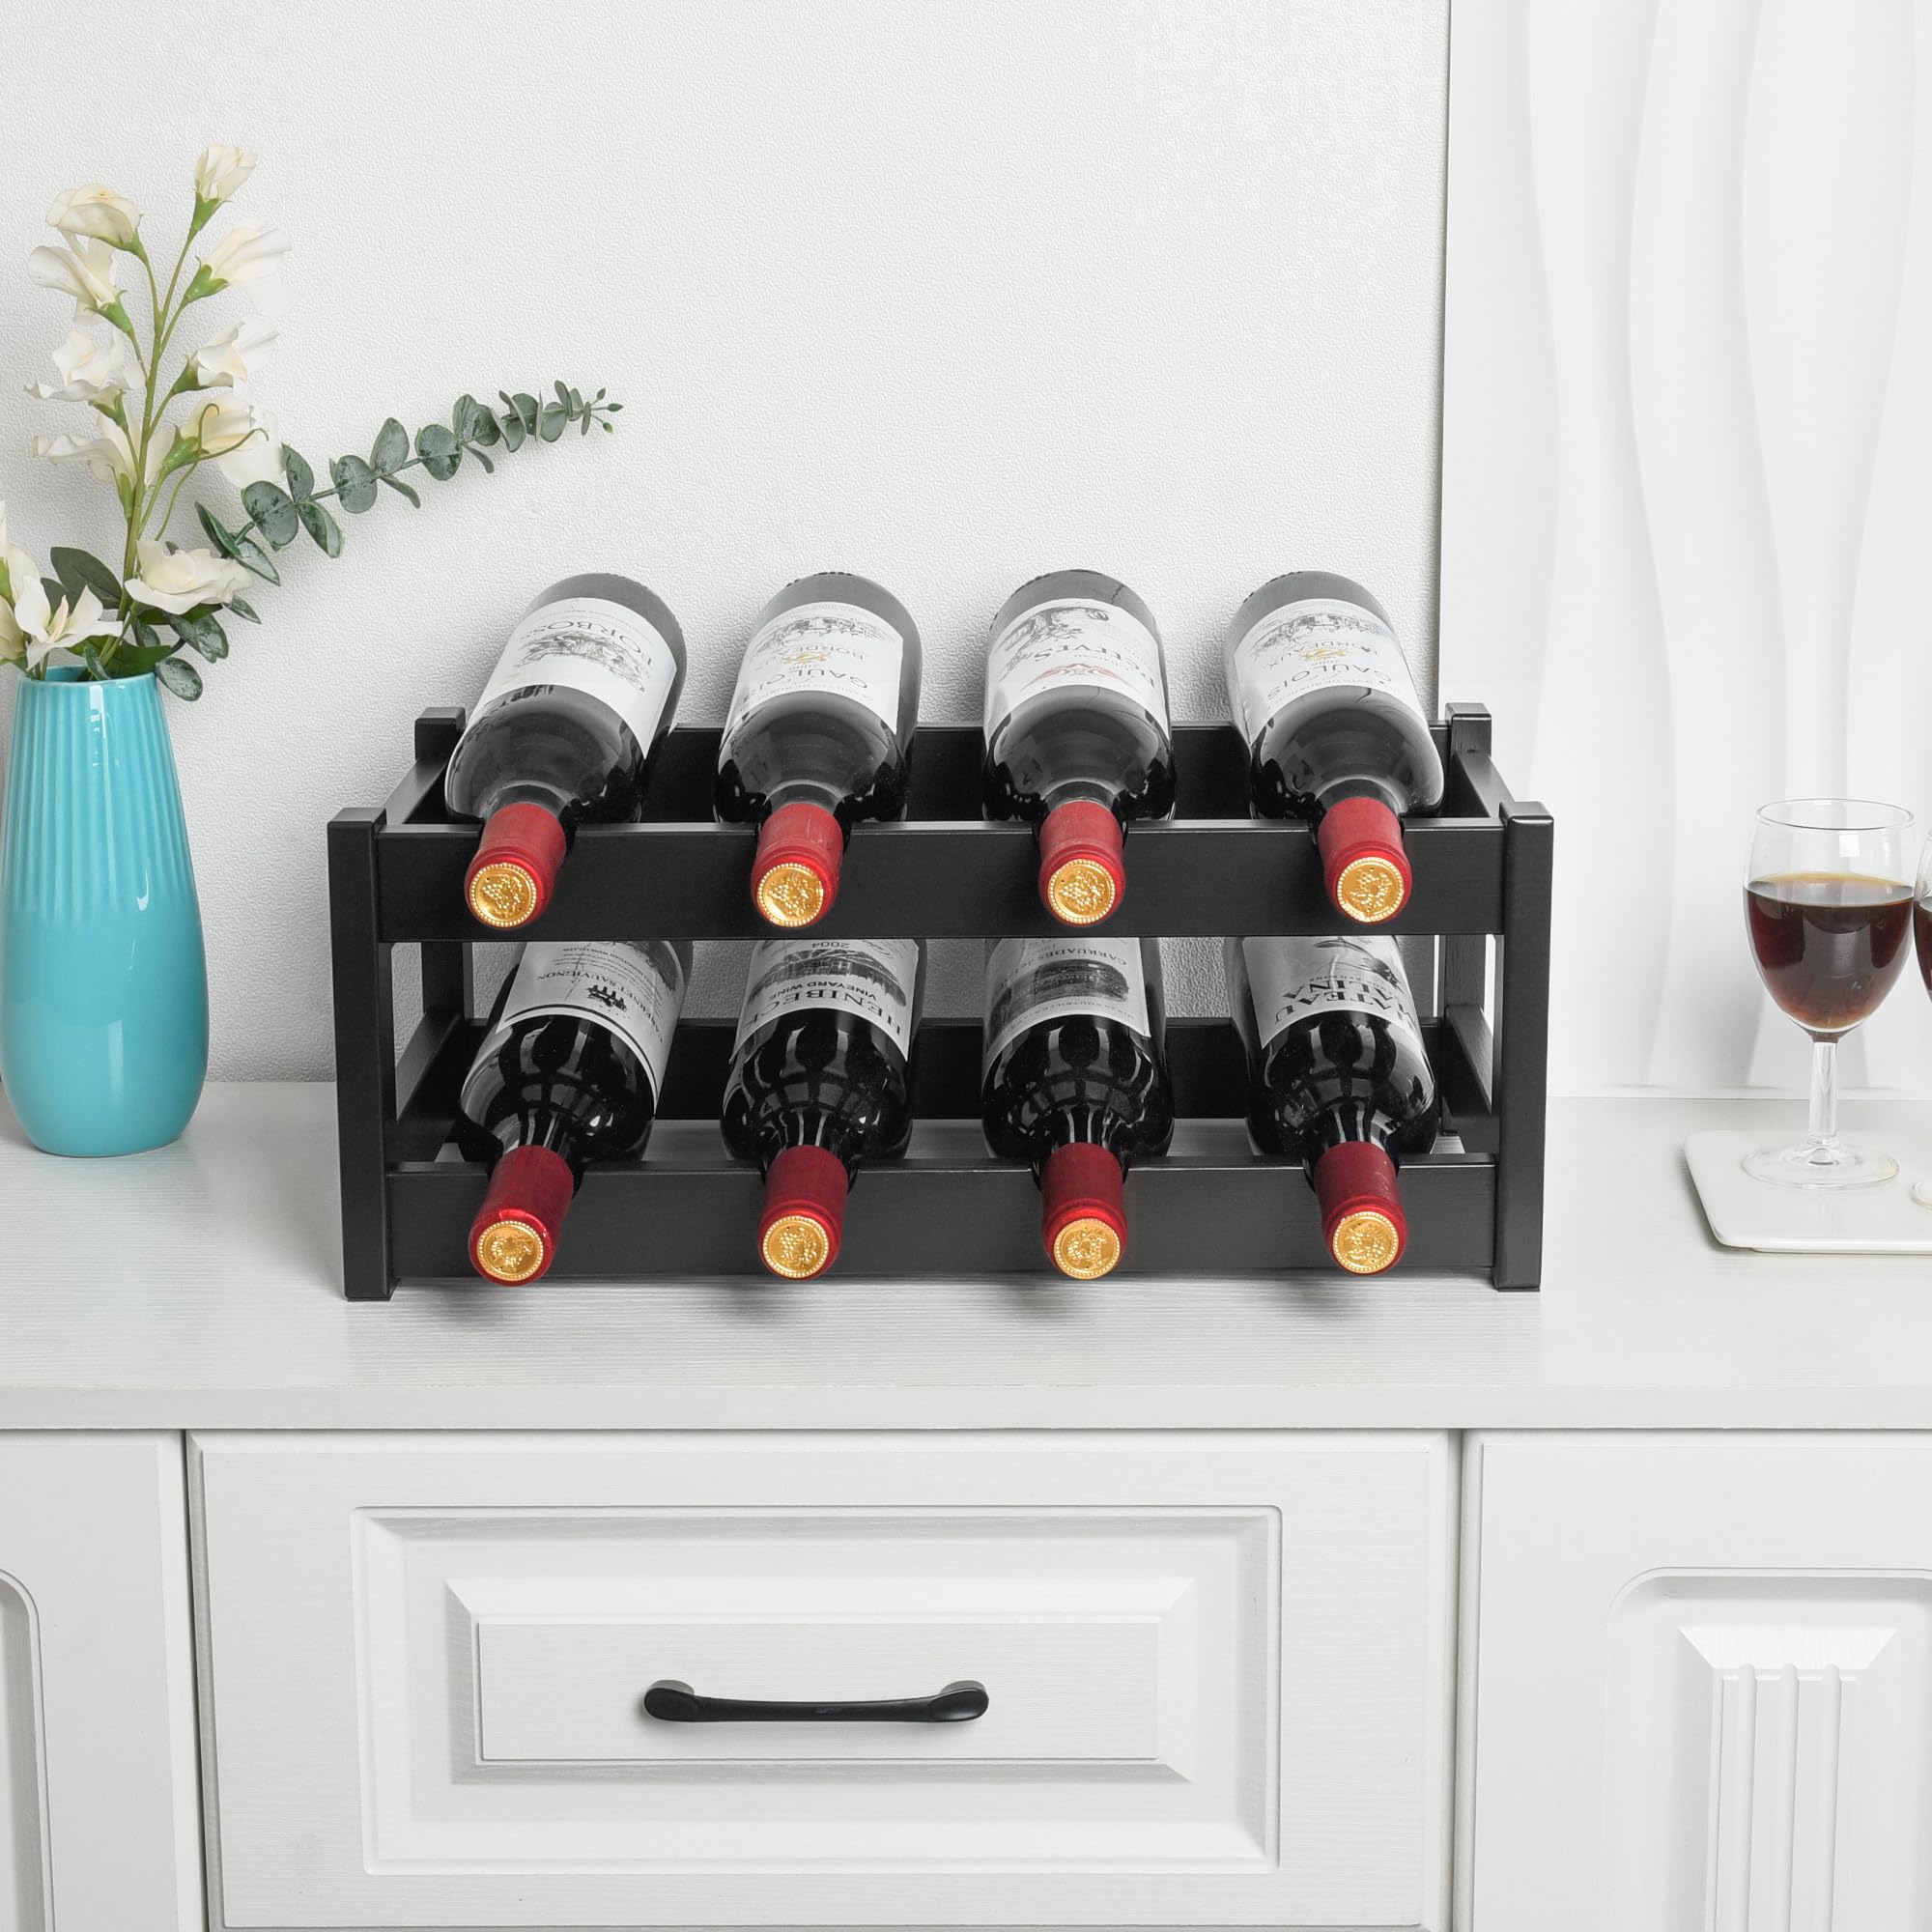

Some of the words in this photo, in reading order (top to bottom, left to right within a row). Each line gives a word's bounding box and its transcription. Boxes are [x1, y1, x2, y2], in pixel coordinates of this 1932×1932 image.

[1268, 664, 1392, 699] GAULOIS
[1037, 949, 1127, 965] CARRUADES
[537, 971, 616, 987] SAUVIGNON
[768, 983, 803, 1001] WINE
[807, 981, 877, 1001] VINEYARD
